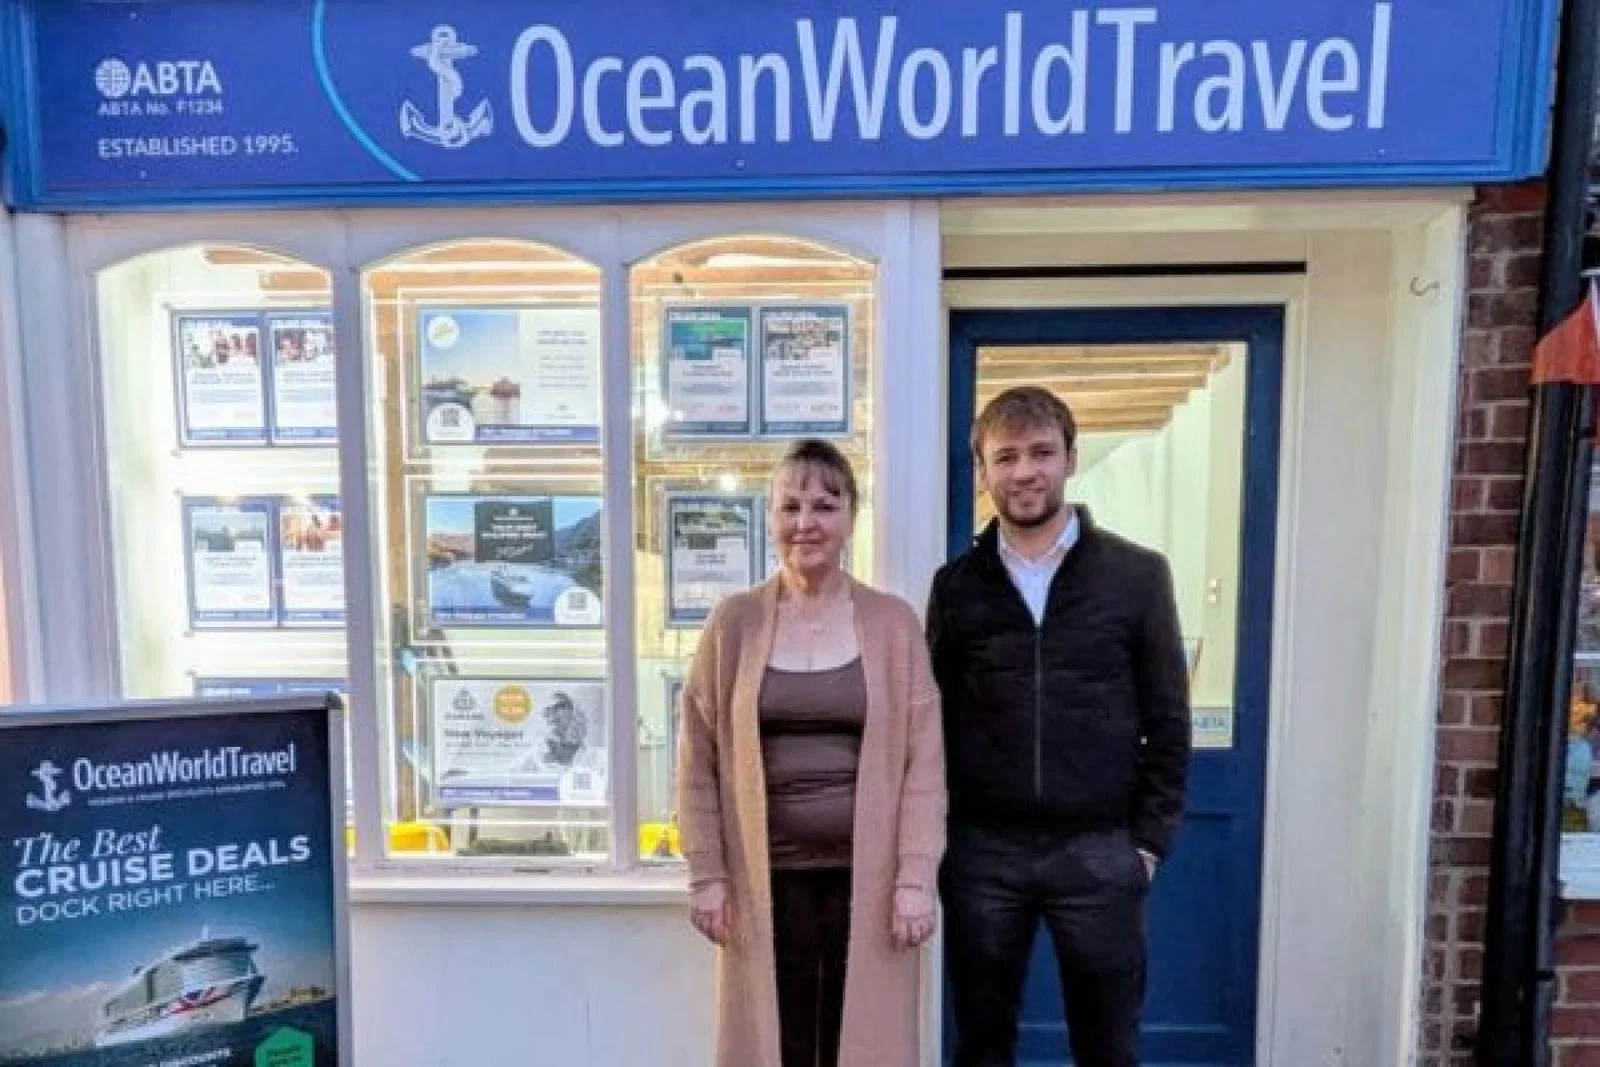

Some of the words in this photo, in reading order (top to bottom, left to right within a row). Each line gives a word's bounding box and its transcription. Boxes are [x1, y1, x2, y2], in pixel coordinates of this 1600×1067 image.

[130, 60, 222, 96] ABTA
[509, 2, 1392, 148] OceanWorldTravel
[99, 101, 142, 115] ABTA
[98, 135, 238, 157] ESTABLISHED
[74, 741, 297, 791] OceanWorldTravel
[13, 831, 80, 867] The
[92, 824, 162, 858] Best
[15, 852, 174, 898] CRUISE
[186, 834, 311, 876] DEALS
[16, 895, 100, 925] DOCK
[108, 882, 187, 912] RIGHT
